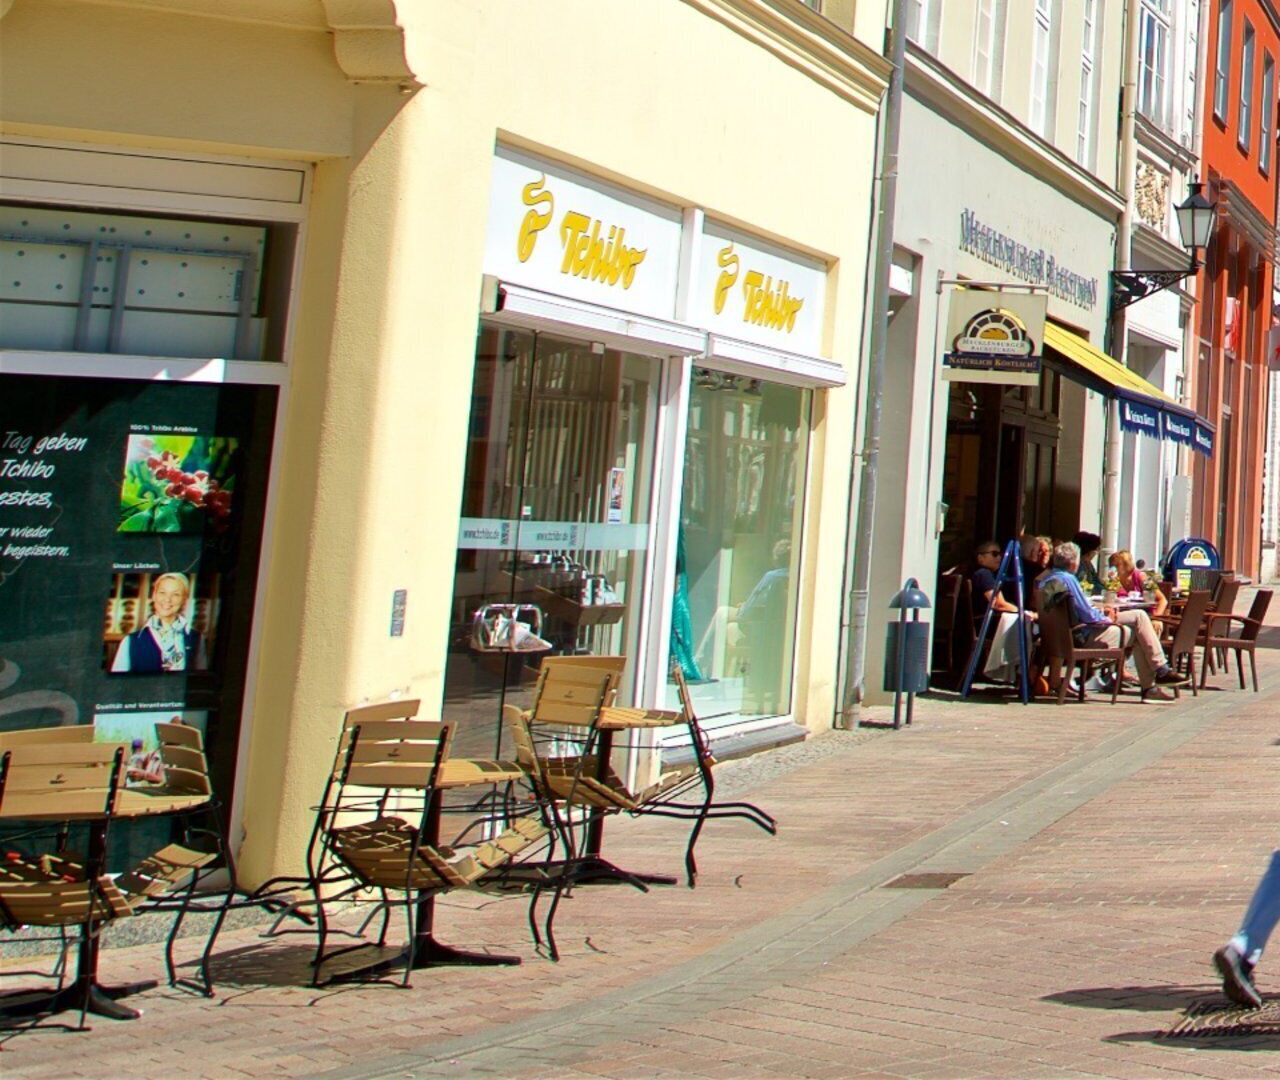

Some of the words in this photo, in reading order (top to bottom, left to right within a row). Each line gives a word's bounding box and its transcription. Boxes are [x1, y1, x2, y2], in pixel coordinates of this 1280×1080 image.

[559, 210, 648, 291] Tchibo
[742, 269, 806, 334] Tchibo
[152, 424, 172, 432] Tchibo
[2, 431, 33, 454] Tag
[33, 432, 88, 455] geben
[0, 459, 56, 478] Tchibo
[10, 525, 54, 538] wieder
[3, 543, 70, 559] begeistern.
